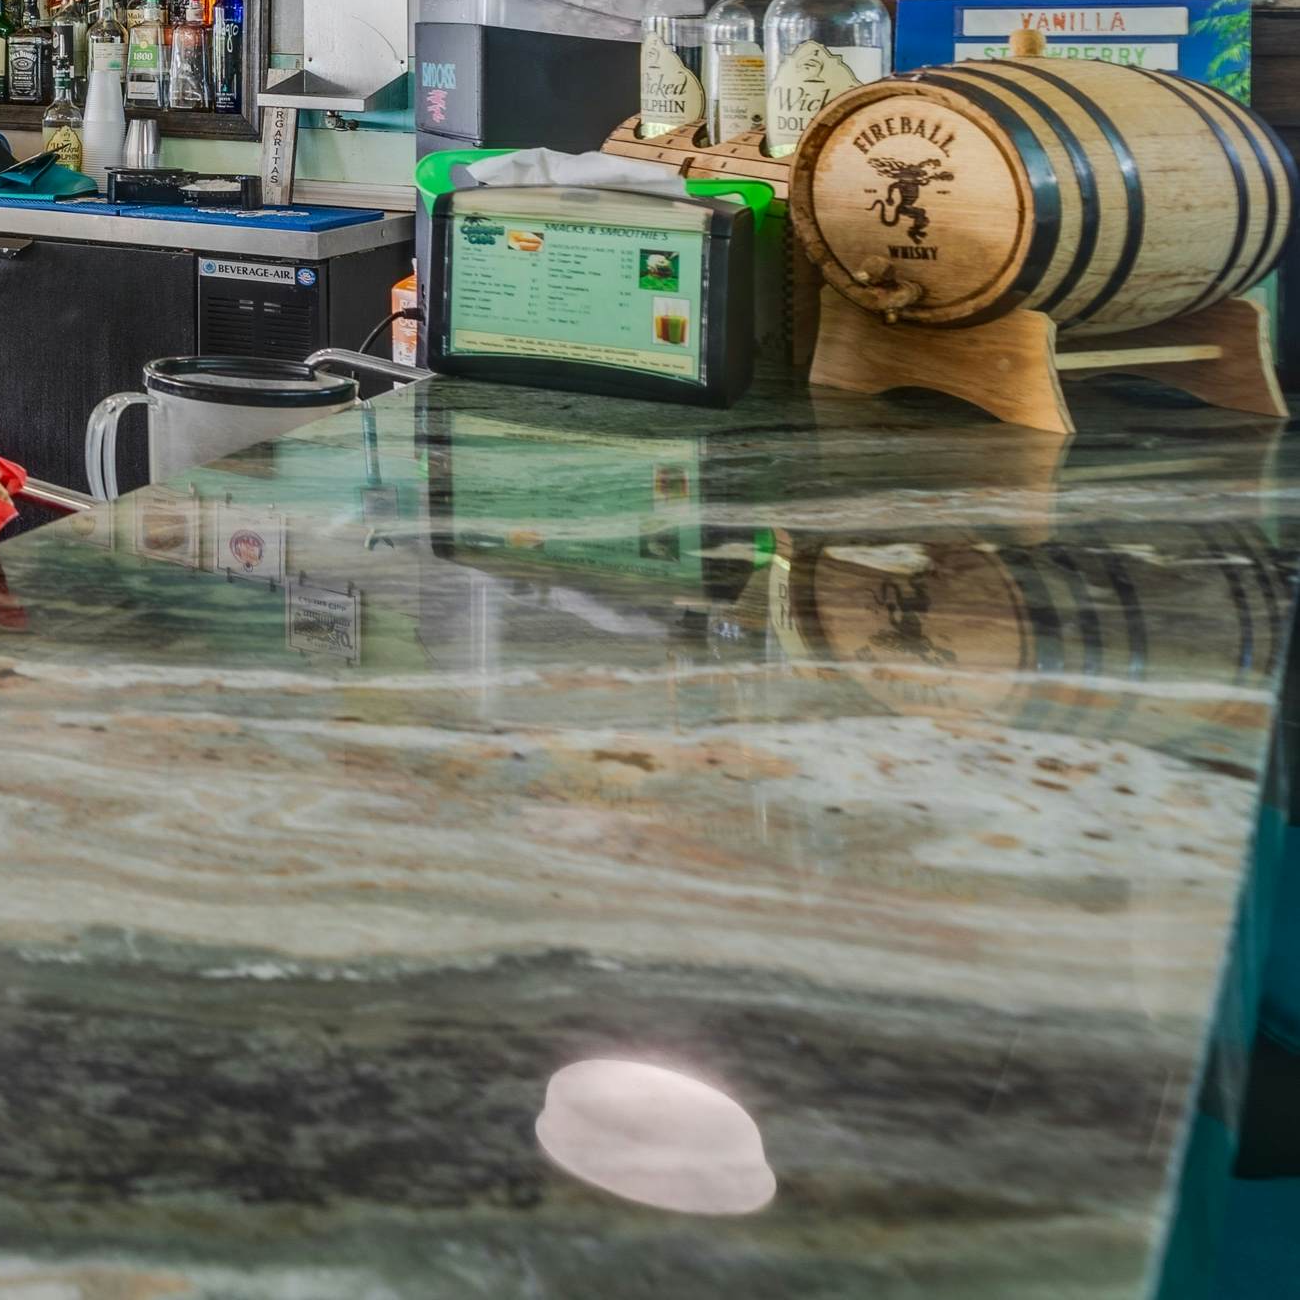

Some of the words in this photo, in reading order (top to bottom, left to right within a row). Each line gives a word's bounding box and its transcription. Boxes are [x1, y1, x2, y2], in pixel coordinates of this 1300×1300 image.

[1020, 11, 1126, 32] VANILLA
[133, 53, 153, 61] 1800
[269, 108, 284, 184] RGARITAS
[853, 116, 957, 158] FIREBALL
[544, 223, 584, 234] SNACKS
[587, 225, 596, 235] &
[888, 245, 938, 260] WHISKY
